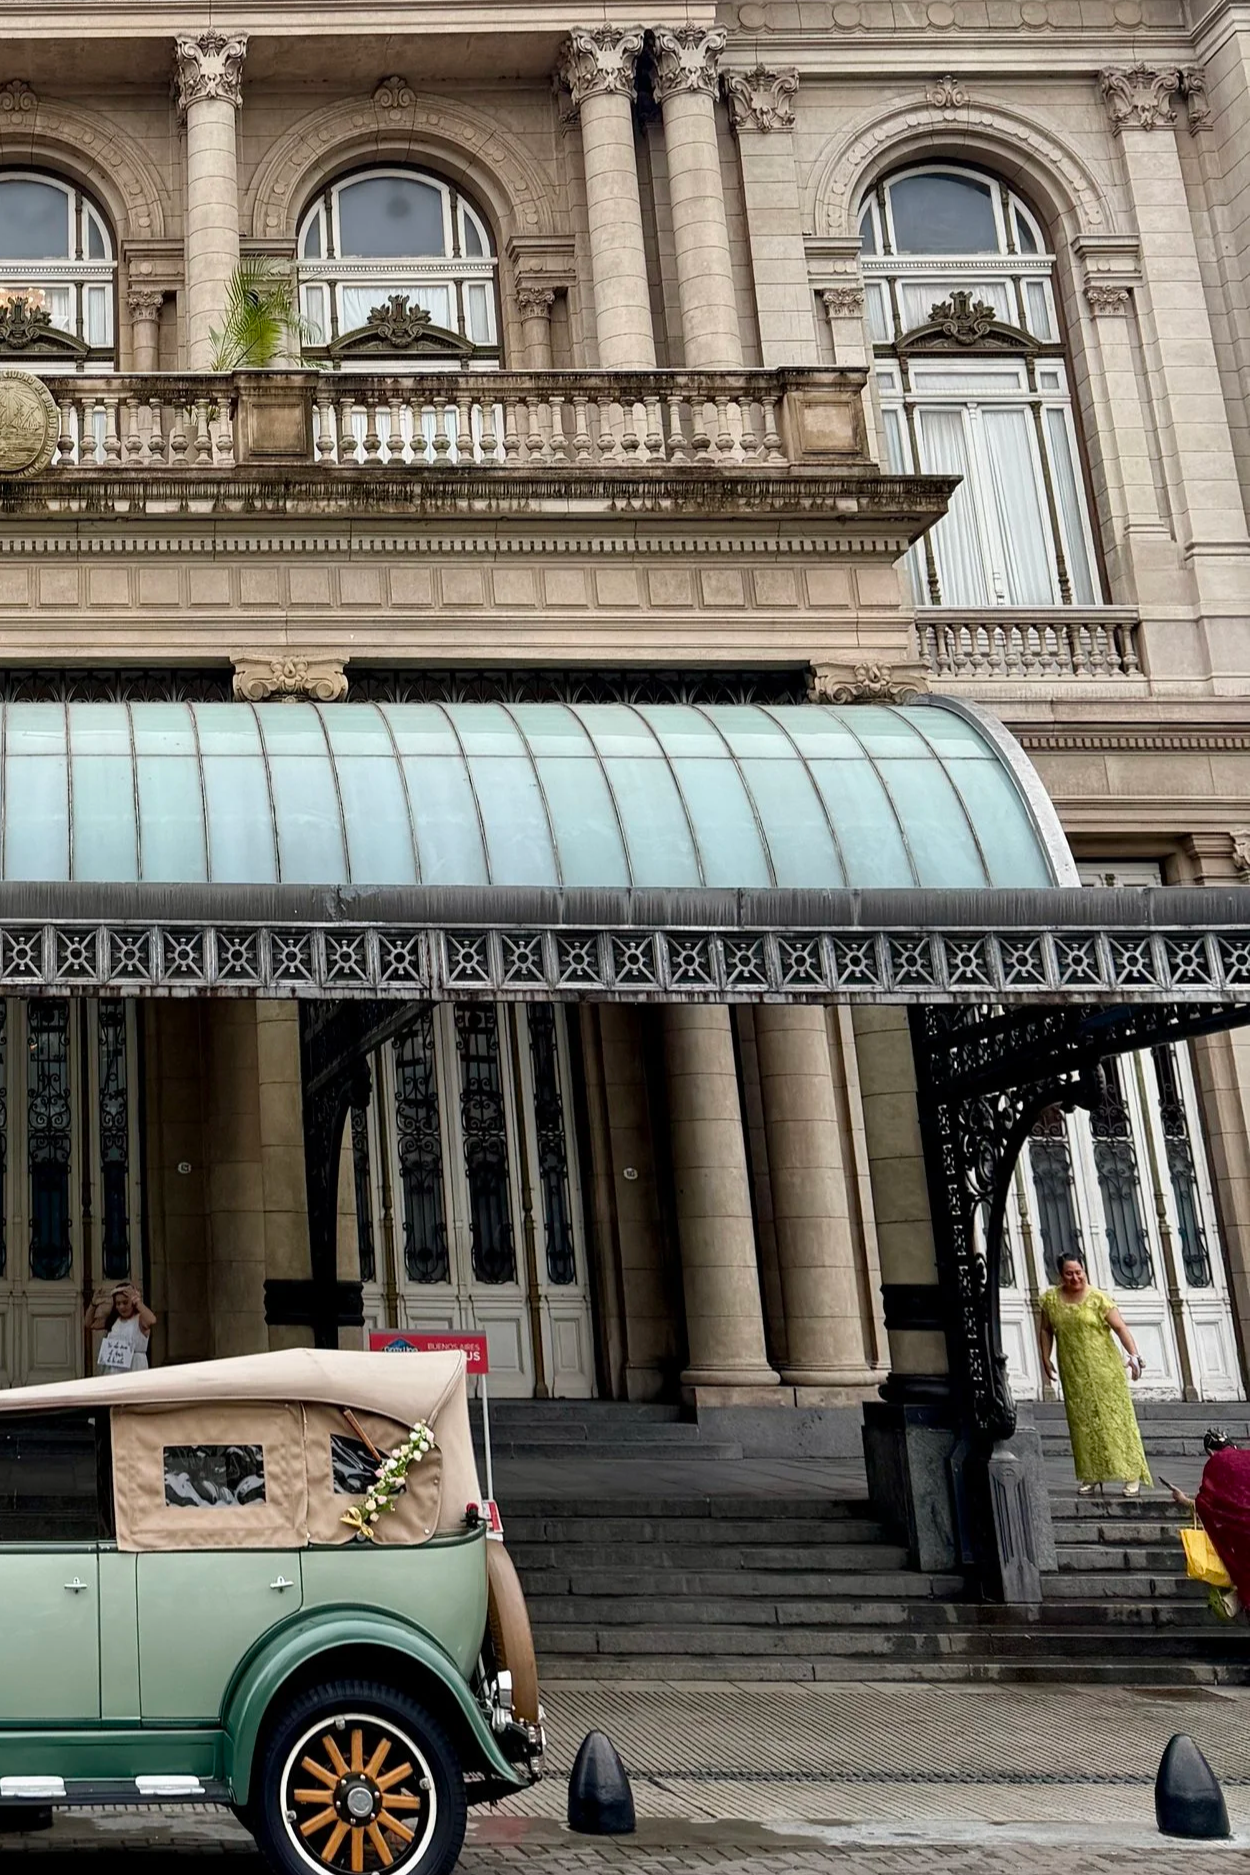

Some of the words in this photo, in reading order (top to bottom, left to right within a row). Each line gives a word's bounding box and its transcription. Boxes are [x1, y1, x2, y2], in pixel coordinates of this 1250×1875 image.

[3, 370, 34, 385] CIUDAD
[42, 397, 57, 429] BUENOS
[459, 1343, 480, 1351] AIRES
[466, 1351, 481, 1361] US
